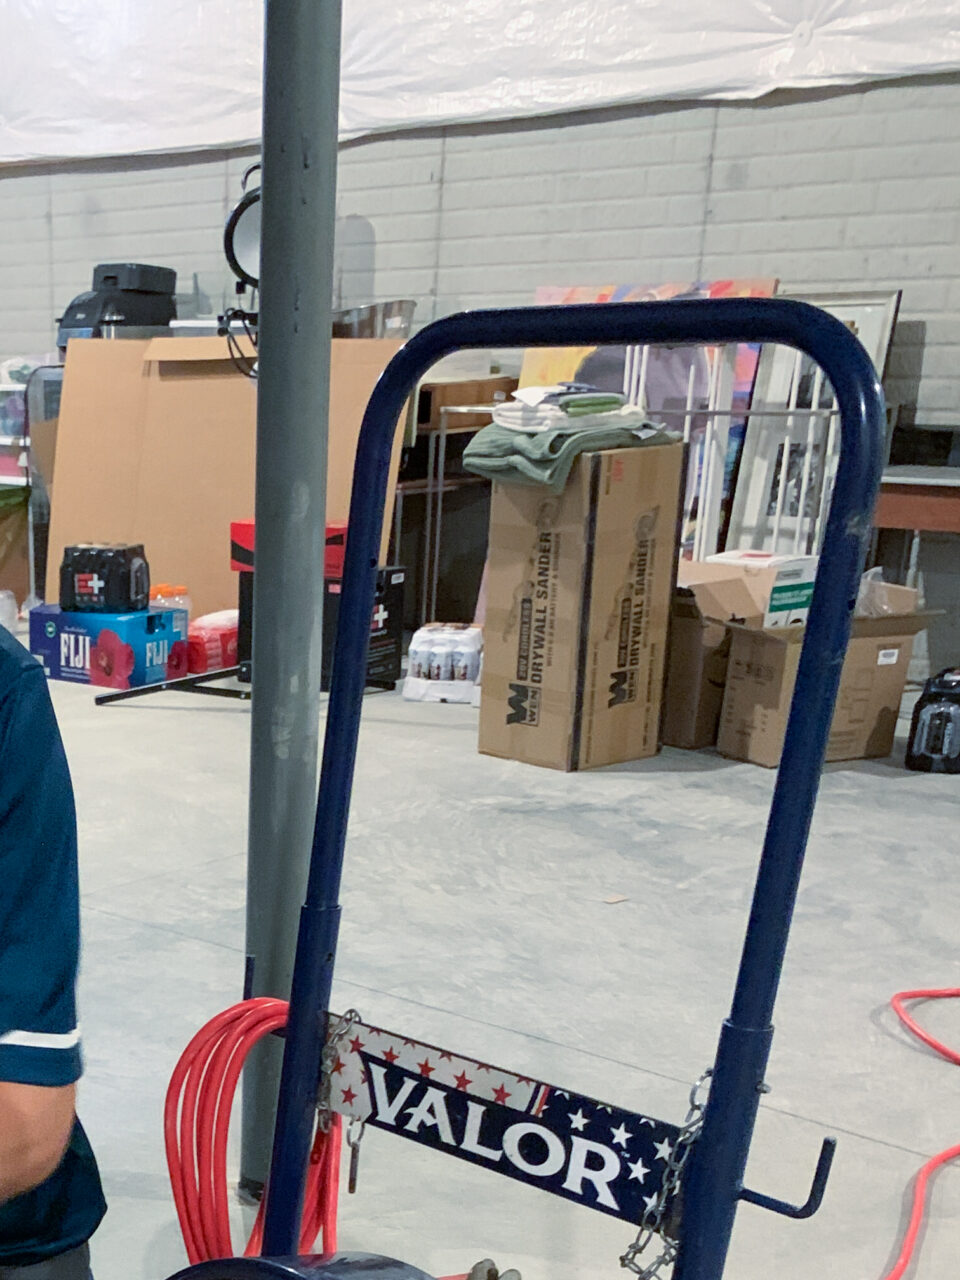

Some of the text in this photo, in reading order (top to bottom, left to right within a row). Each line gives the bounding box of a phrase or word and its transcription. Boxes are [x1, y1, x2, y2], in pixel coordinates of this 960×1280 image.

[634, 539, 649, 597] SANDER
[531, 531, 552, 684] DRYWALL SANDER
[629, 600, 645, 666] DRYWALL
[60, 633, 90, 669] FIJI
[146, 640, 168, 667] FIJI
[368, 1061, 621, 1212] VALOR
